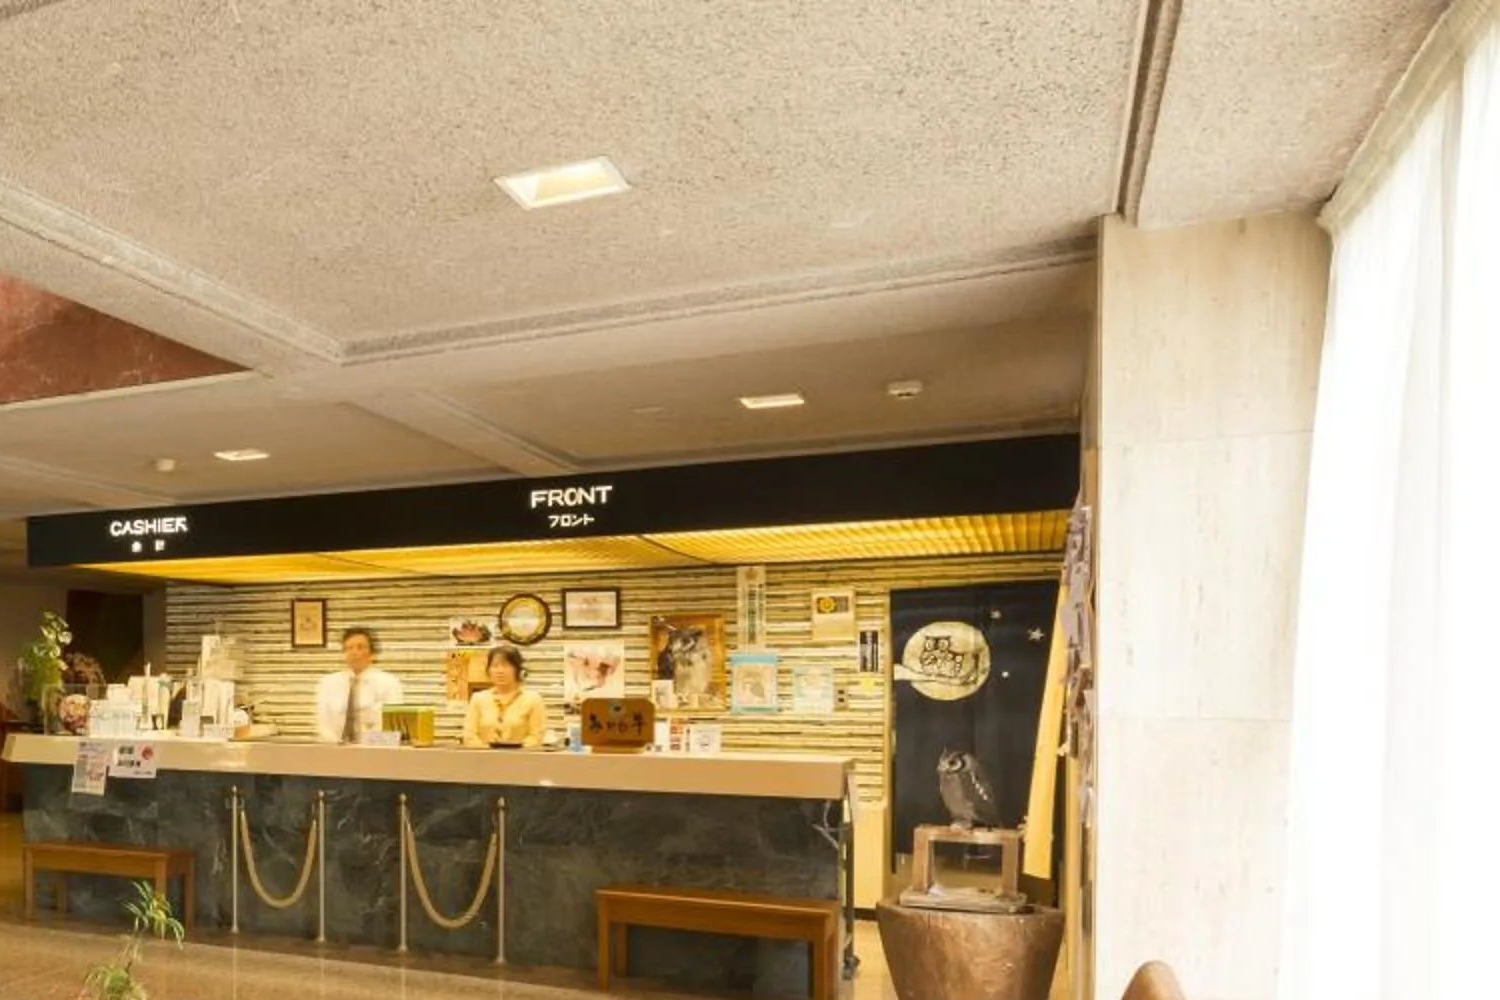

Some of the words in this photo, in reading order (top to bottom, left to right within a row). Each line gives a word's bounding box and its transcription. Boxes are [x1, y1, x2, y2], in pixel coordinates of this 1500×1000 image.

[531, 485, 613, 508] FRONT
[110, 516, 188, 536] CASHIER
[548, 513, 595, 528] フロント
